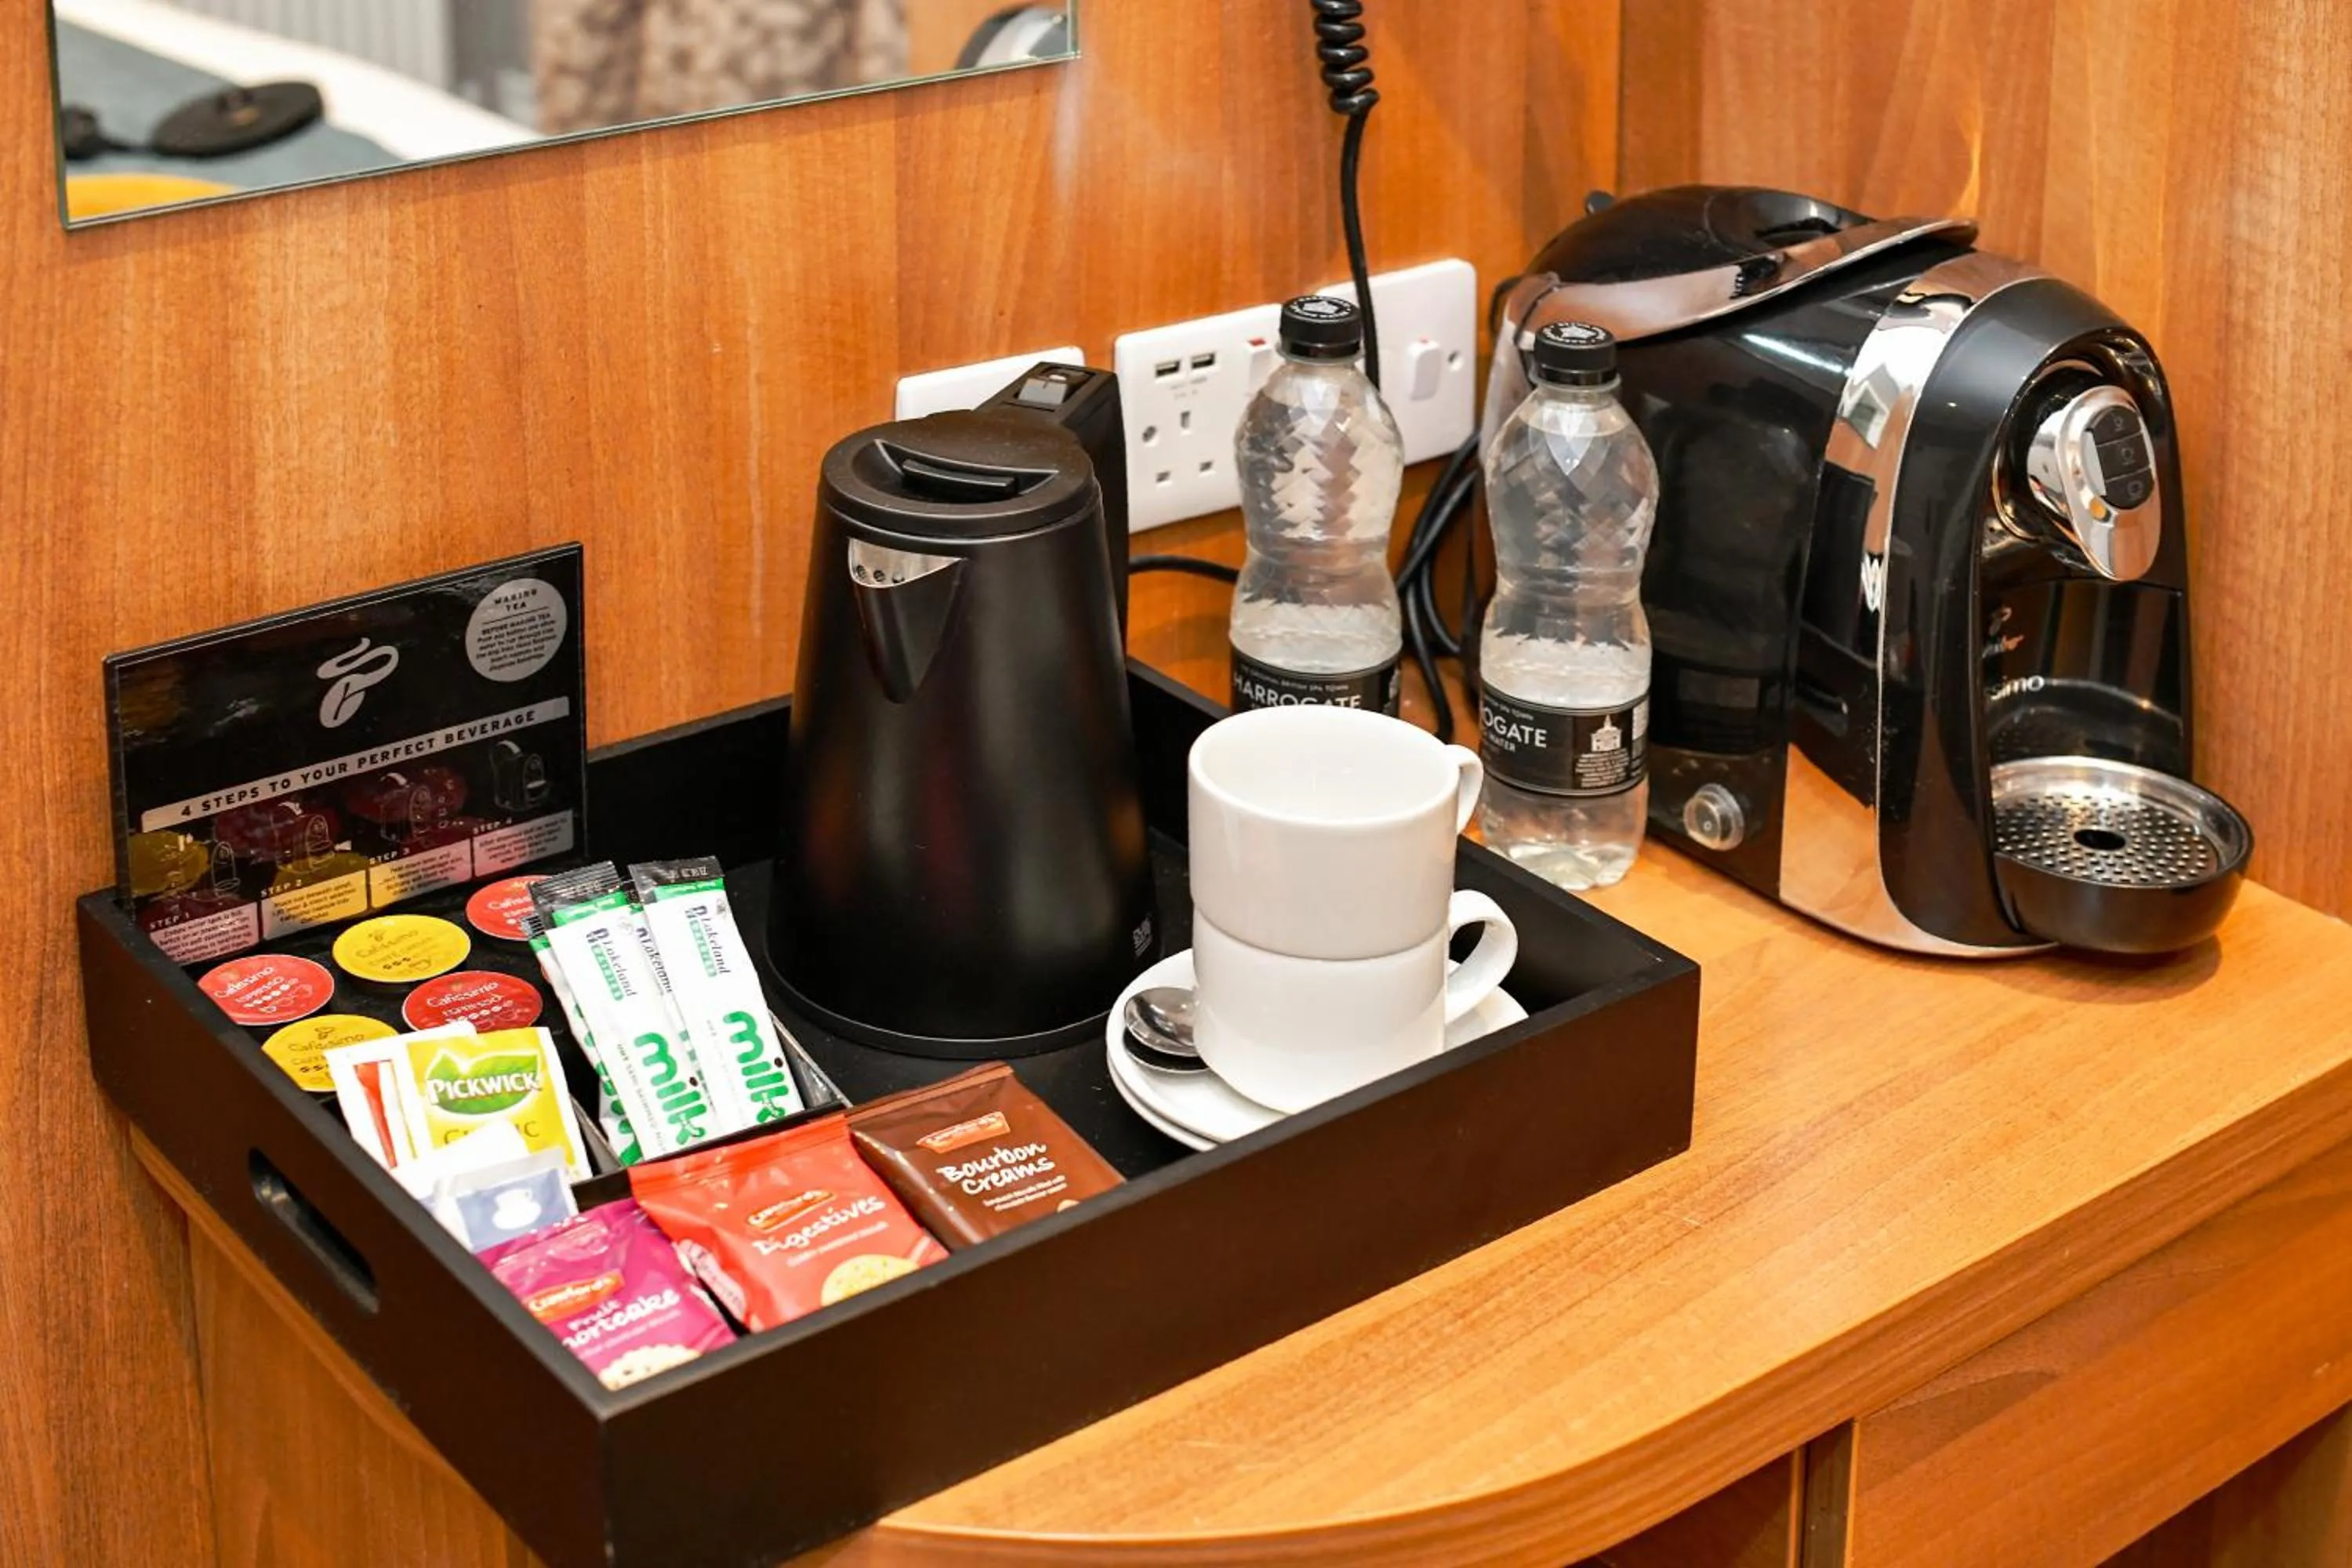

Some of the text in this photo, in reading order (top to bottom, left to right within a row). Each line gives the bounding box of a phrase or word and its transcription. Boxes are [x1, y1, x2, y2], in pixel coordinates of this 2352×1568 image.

[506, 601, 527, 612] TEA
[180, 710, 536, 817] 4 STEPS TO YOUR PERFECT BEVERAGE
[369, 851, 398, 865] STEP
[260, 882, 291, 898] STEP
[149, 915, 180, 930] STEP
[722, 1010, 789, 1123] milk
[425, 1071, 543, 1107] PICKWICK
[633, 1032, 707, 1145] milk
[935, 1142, 1047, 1182] Bourbon
[962, 1156, 1056, 1196] Creams
[752, 1196, 887, 1256] Digestives
